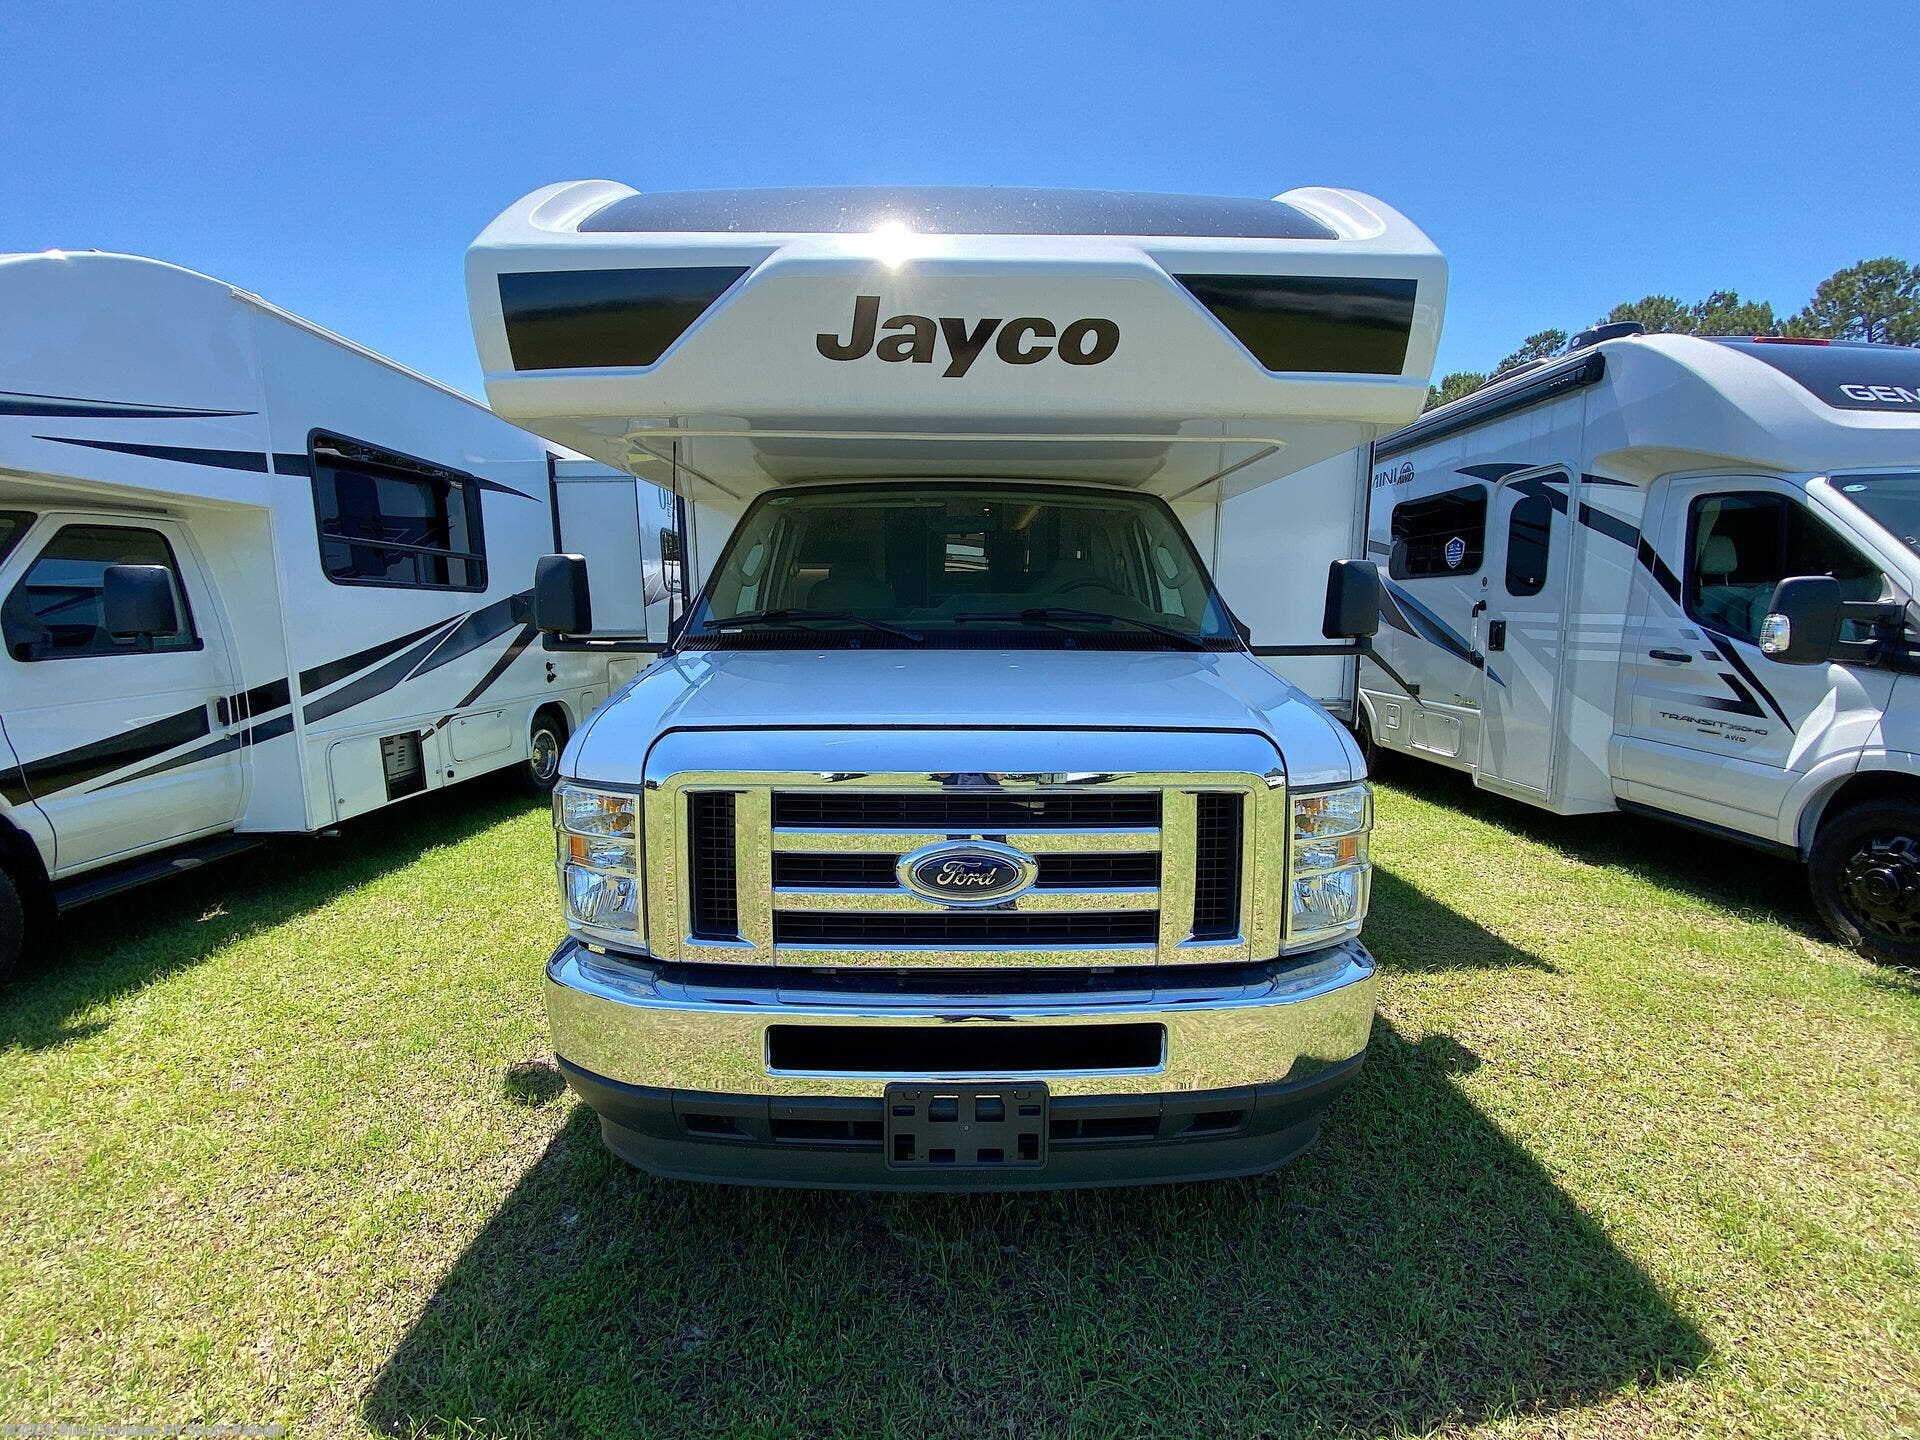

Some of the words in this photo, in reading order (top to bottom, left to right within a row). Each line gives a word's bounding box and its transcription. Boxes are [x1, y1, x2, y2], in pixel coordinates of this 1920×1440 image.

[816, 296, 1120, 378] Jayco
[1660, 711, 1727, 728] TRANSIT
[1724, 734, 1747, 743] AWD
[936, 861, 998, 886] Ford
